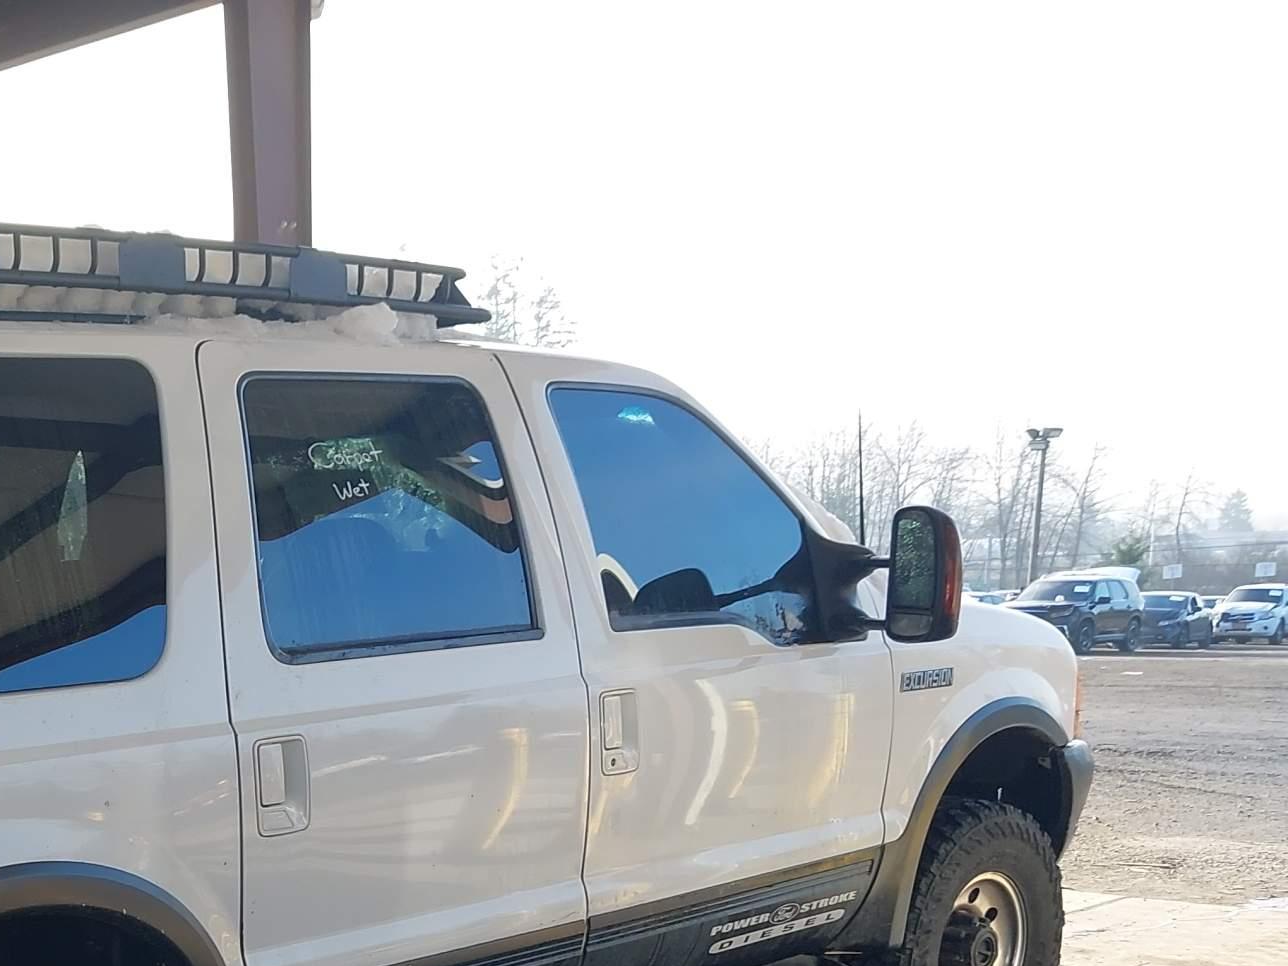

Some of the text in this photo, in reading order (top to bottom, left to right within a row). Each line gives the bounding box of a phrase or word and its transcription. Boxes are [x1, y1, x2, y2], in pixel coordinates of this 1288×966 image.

[332, 478, 370, 500] Wet
[902, 668, 953, 690] EXCURSION
[710, 912, 770, 936] POWER
[799, 890, 857, 913] STROKE
[718, 913, 836, 950] DIESEL
